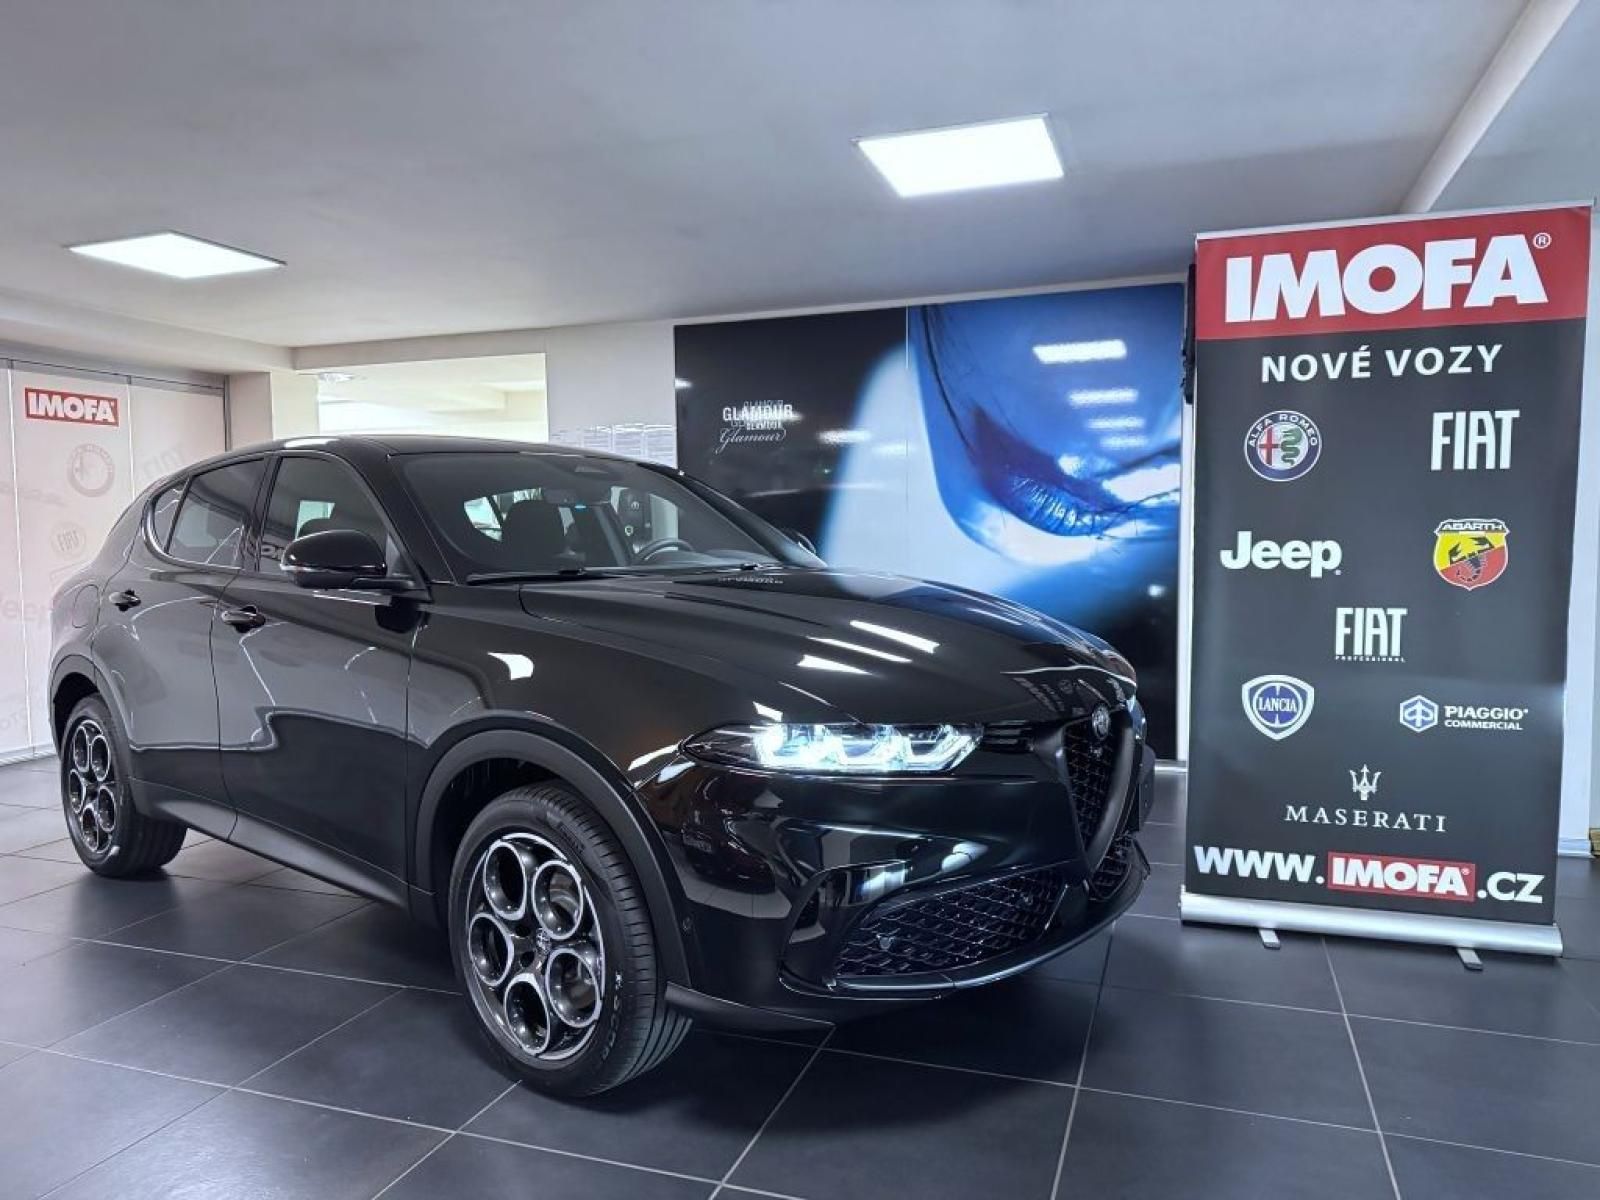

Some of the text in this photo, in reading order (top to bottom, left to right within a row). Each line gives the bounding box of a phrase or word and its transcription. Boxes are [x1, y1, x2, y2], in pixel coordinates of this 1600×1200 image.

[1261, 344, 1502, 383] NOVÉ VOZY
[27, 391, 115, 423] IMOFA
[1249, 413, 1318, 448] ALFA ROMEO
[1430, 409, 1520, 471] FIAT
[1220, 530, 1342, 578] Jeep
[1335, 607, 1408, 656] FIAT
[1256, 696, 1298, 712] LANCIA
[1444, 705, 1524, 721] PIAGGIO
[1444, 719, 1523, 731] COMMERCIAL
[1284, 805, 1447, 833] MASERATI
